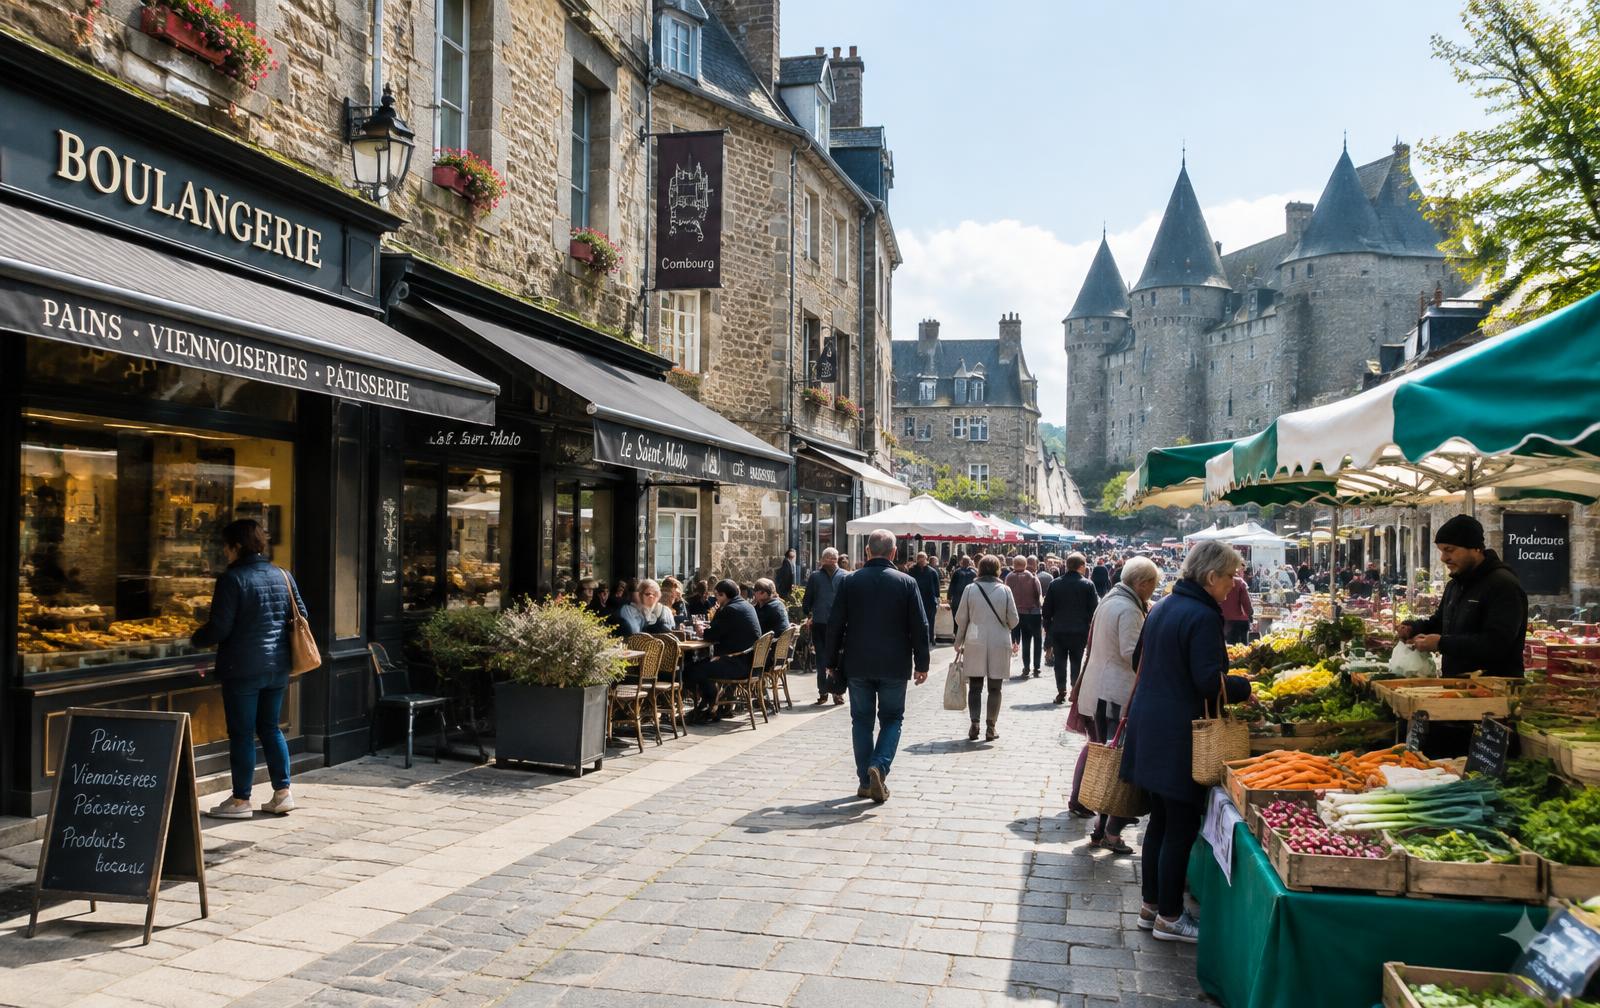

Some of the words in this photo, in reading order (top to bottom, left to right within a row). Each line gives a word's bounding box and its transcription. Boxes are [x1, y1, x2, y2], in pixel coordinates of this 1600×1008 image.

[57, 128, 322, 269] BOULANGERIE
[661, 257, 714, 272] Combourg
[42, 298, 122, 341] PAINS
[149, 323, 308, 381] VIENNOISERIES
[620, 431, 633, 458] Le
